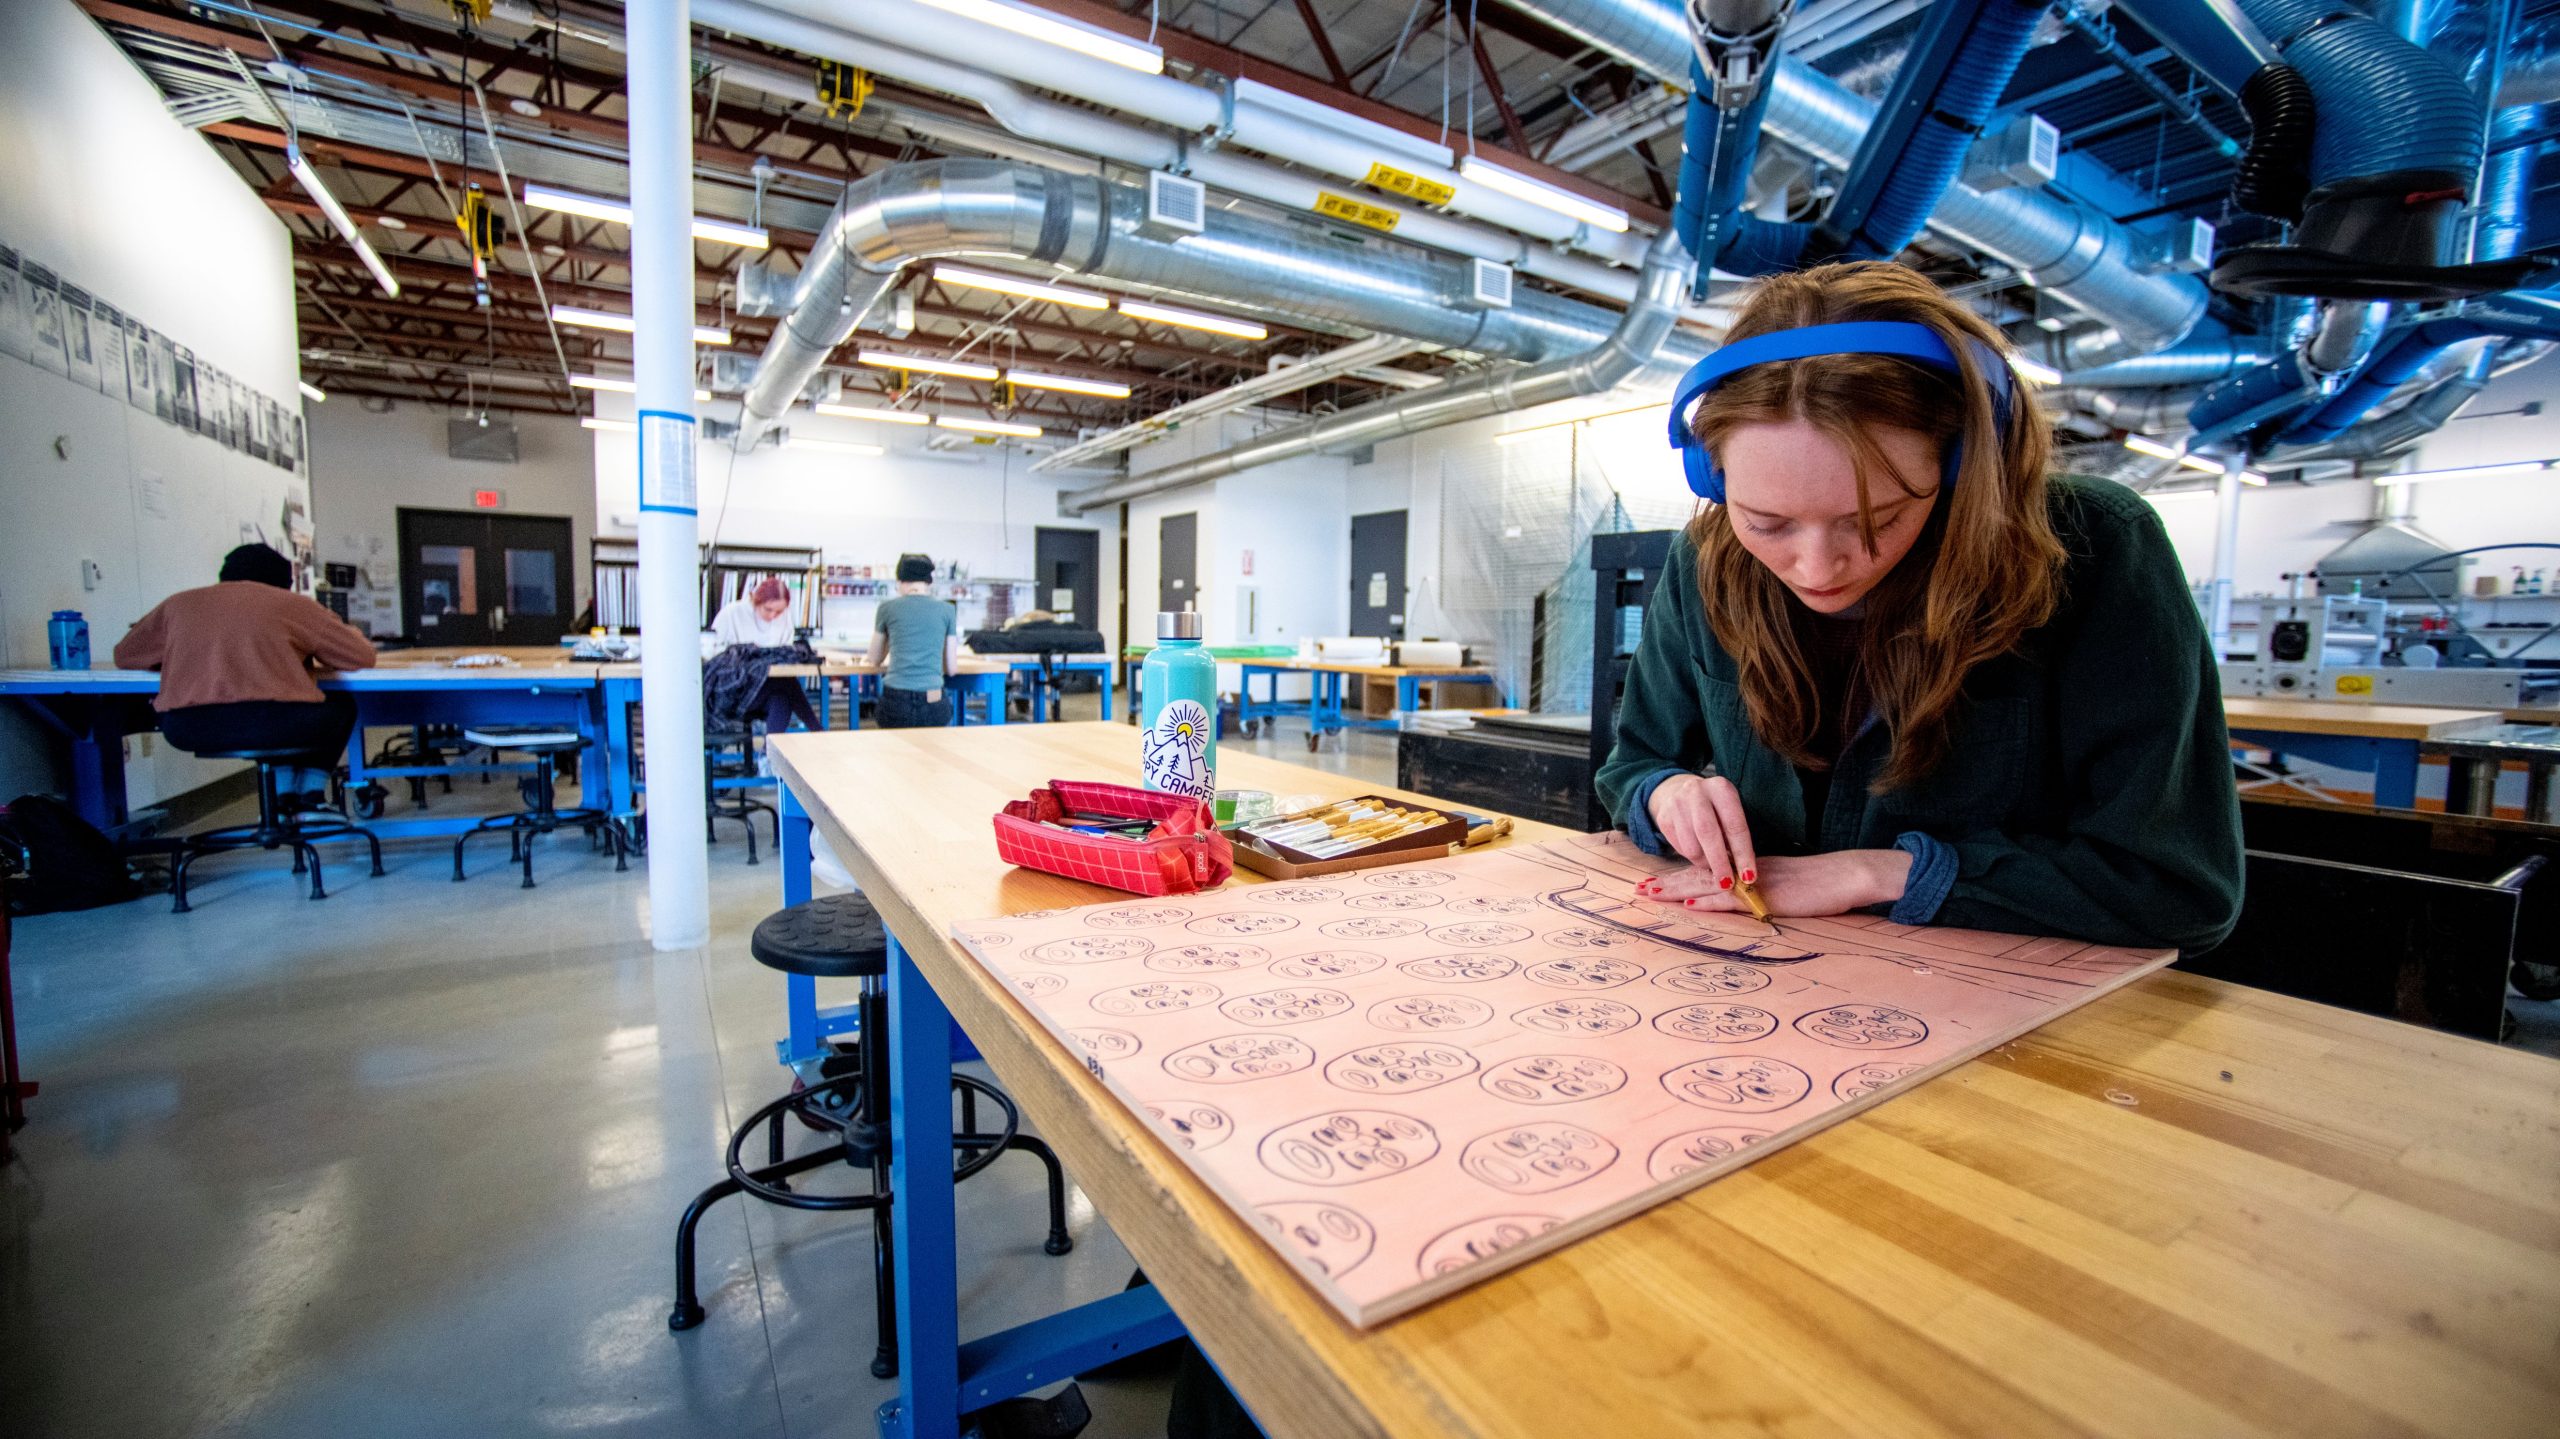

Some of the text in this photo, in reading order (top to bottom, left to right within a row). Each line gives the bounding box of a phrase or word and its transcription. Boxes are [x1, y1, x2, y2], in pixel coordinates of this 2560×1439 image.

[1143, 756, 1214, 807] PY CAMPER
[1197, 851, 1206, 873] yoobi
